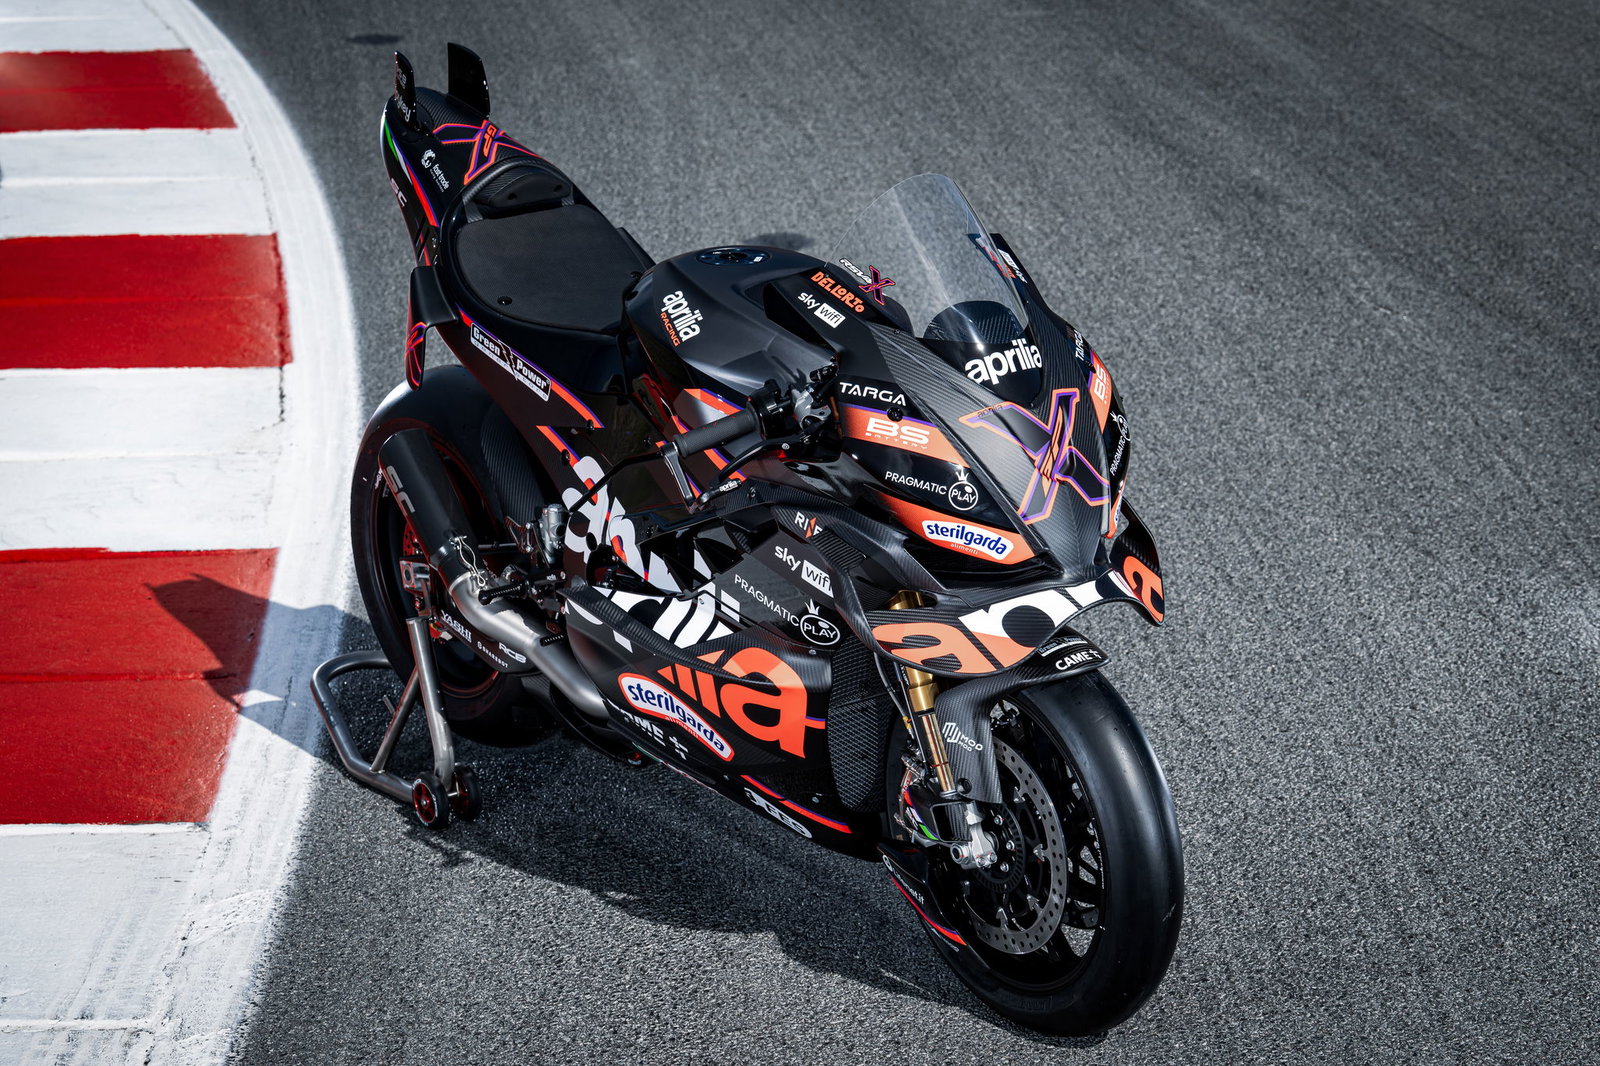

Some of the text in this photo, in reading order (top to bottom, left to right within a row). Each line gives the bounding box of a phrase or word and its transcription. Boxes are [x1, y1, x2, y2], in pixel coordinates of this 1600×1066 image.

[660, 290, 704, 342] aprilia
[797, 292, 843, 324] sky wifi
[660, 311, 681, 347] RACING
[473, 326, 547, 390] Green Power
[964, 337, 1043, 386] aprilia
[839, 381, 907, 407] TARGA
[866, 417, 930, 446] BS
[884, 470, 977, 504] PRAGMATIC PLAY
[926, 523, 1008, 555] sterilgarda
[950, 543, 979, 555] alimenti
[774, 545, 801, 572] sky
[734, 573, 836, 639] PRAGMATIC PLAY
[441, 609, 472, 643] YASHI
[498, 642, 527, 664] RCB
[1055, 651, 1093, 670] CAME
[627, 683, 725, 752] sterilgarda
[960, 734, 983, 751] MOD
